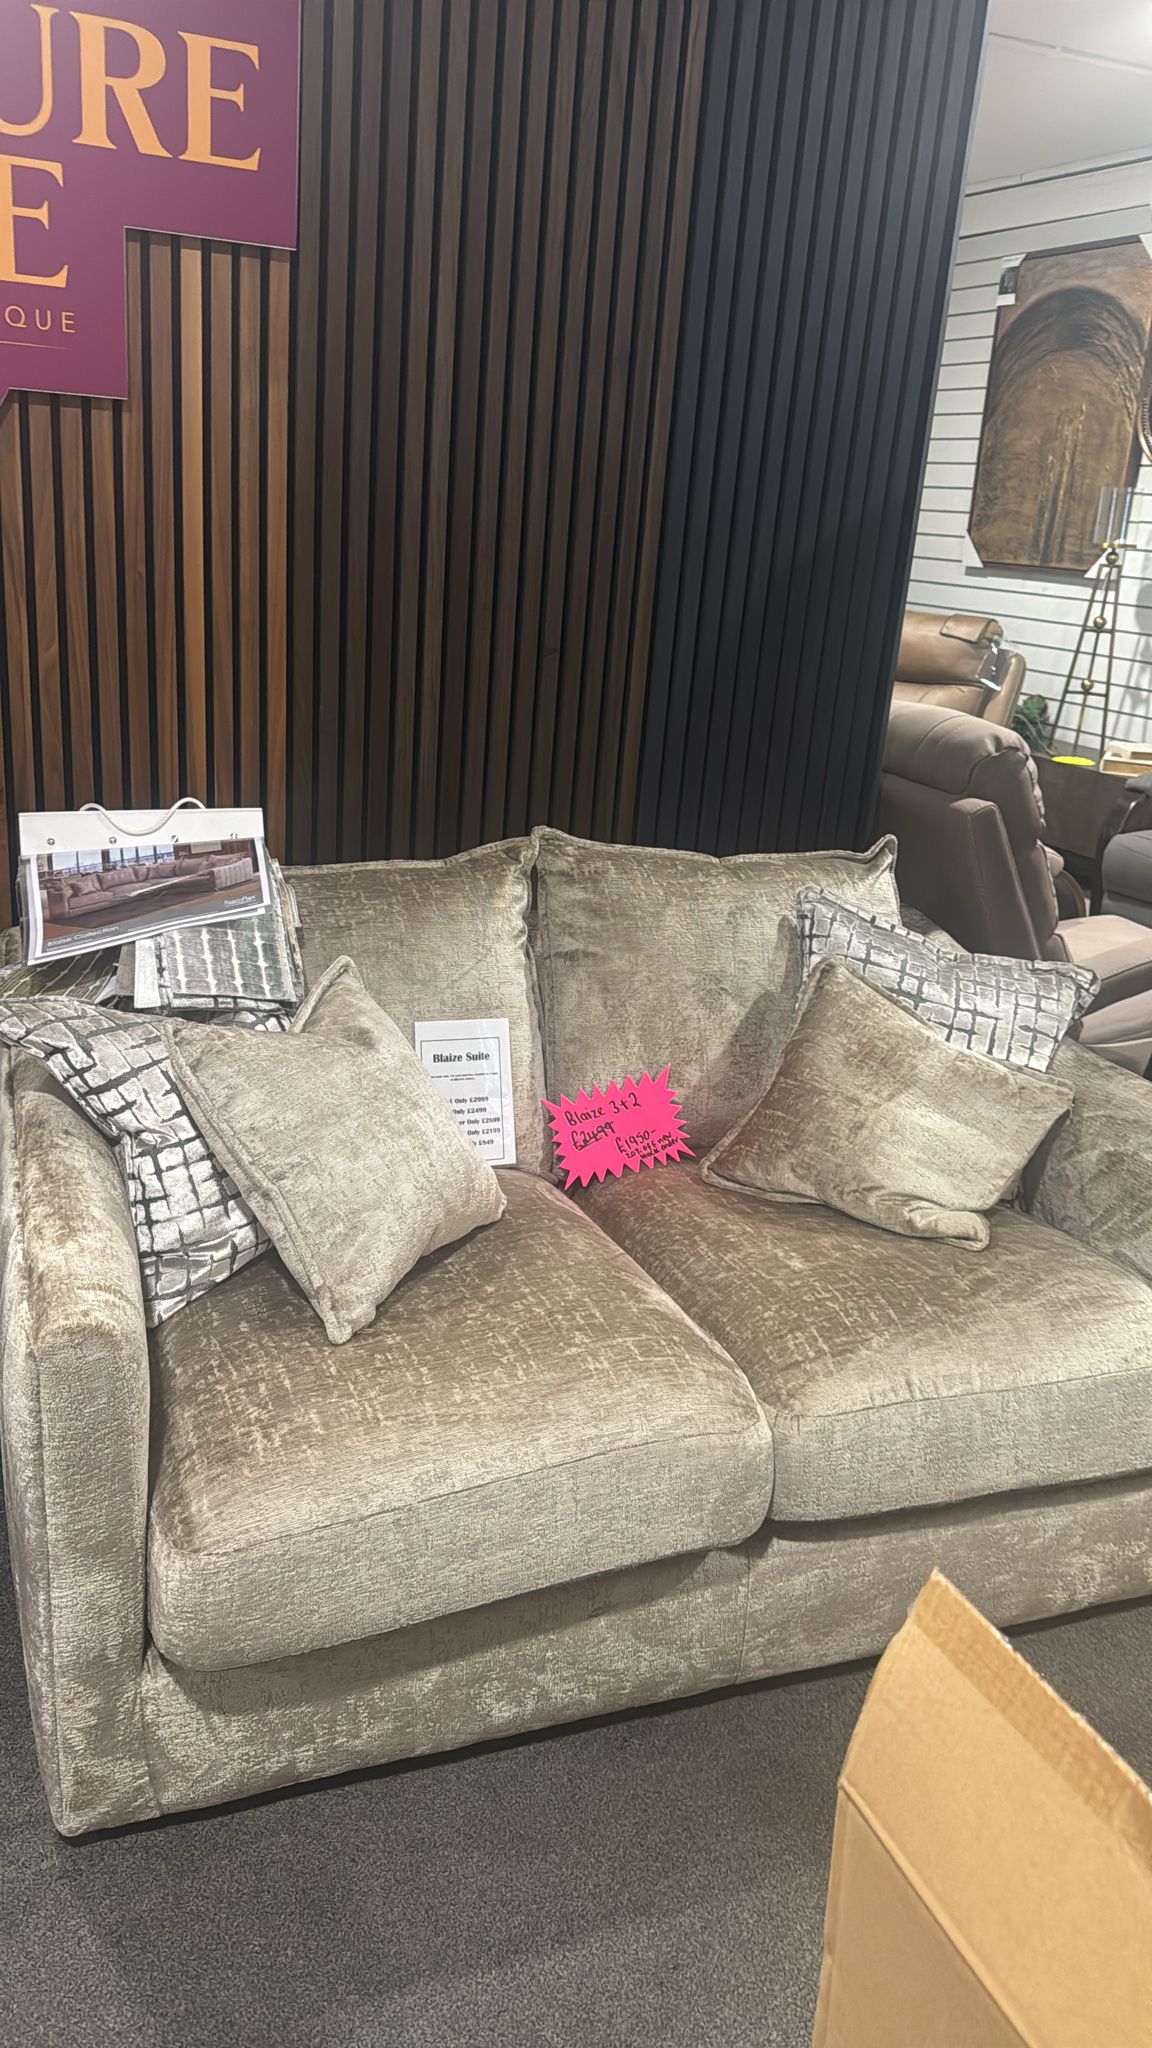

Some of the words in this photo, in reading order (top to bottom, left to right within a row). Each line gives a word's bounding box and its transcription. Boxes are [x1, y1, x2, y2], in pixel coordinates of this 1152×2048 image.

[4, 305, 76, 333] QUE
[73, 925, 119, 940] Collection
[432, 1053, 463, 1063] Blaize
[465, 1051, 490, 1062] Suite
[564, 1107, 605, 1126] Blaize
